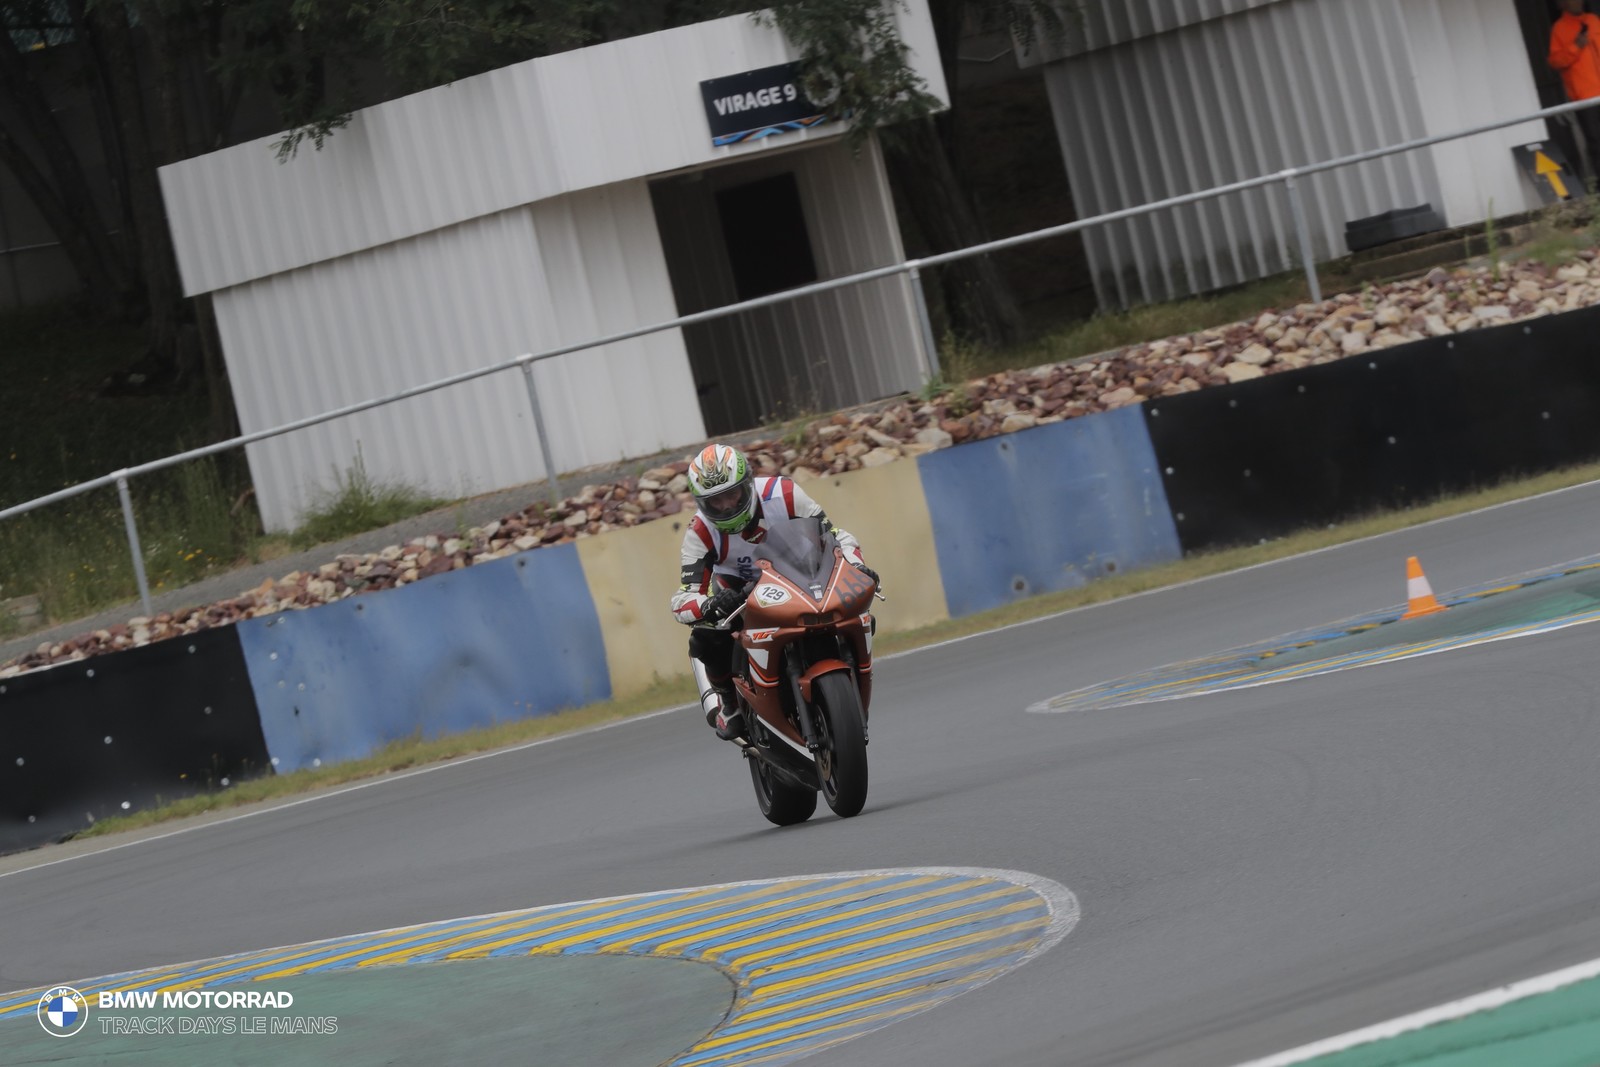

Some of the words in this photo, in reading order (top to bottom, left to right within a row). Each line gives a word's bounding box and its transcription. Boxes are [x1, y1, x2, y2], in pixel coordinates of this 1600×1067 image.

[713, 86, 782, 116] VIRAGE
[783, 83, 797, 102] 9
[761, 586, 784, 601] 129
